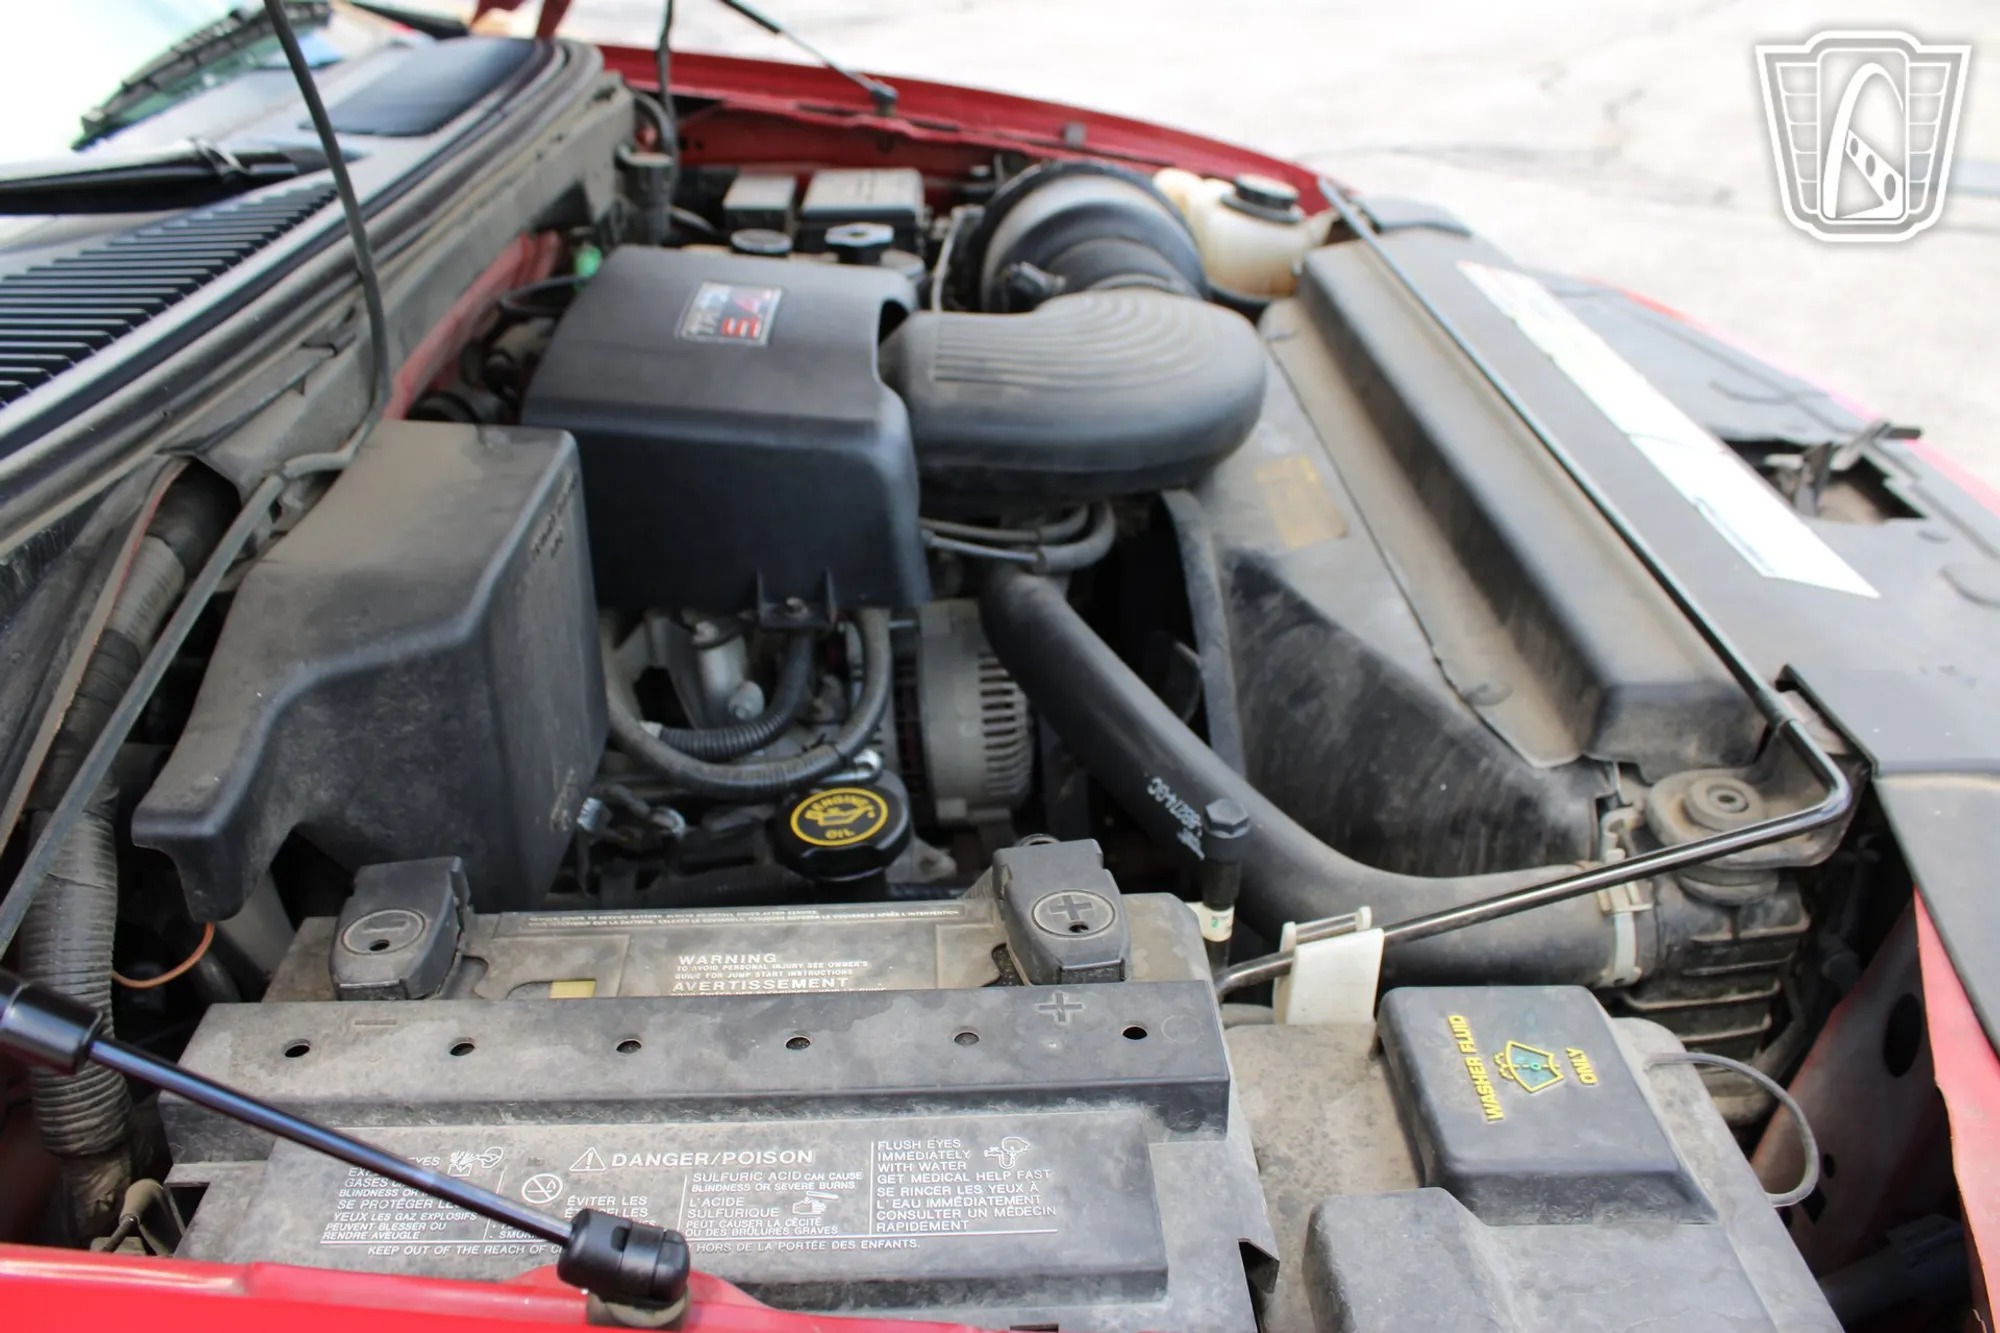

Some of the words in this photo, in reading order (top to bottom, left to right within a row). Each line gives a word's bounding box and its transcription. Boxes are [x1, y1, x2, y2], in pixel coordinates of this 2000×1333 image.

[825, 828, 855, 840] OIL
[679, 953, 777, 965] WARNING
[691, 964, 718, 972] AVOID
[722, 963, 768, 971] PERSONAL
[727, 970, 752, 979] JUMP
[787, 968, 853, 977] INSTRUCTIONS
[672, 977, 849, 992] AVERTISSEMENT
[1448, 1014, 1477, 1054] FLUID
[1566, 1047, 1599, 1085] ONLY
[1464, 1056, 1505, 1124] WASHER
[877, 1139, 921, 1150] FLUSH
[927, 1138, 961, 1149] EYES
[611, 1150, 814, 1168] DANGER/POISON
[877, 1149, 970, 1162] IMMEDIATELY
[877, 1162, 914, 1173] WITH
[919, 1160, 967, 1172] WATER
[692, 1171, 763, 1183] SULFURIC
[768, 1170, 801, 1182] ACID
[804, 1172, 825, 1182] CAN
[829, 1171, 863, 1181] CAUSE
[877, 1173, 905, 1184] GET
[911, 1172, 970, 1184] MEDICAL
[976, 1170, 1012, 1181] HELP
[1017, 1169, 1052, 1180] FAST
[344, 1178, 388, 1188] GASES
[691, 1183, 751, 1193] BLINDNESS
[755, 1182, 770, 1192] OR
[774, 1181, 815, 1191] SEVERE
[819, 1181, 856, 1190] BURNS
[877, 1186, 896, 1197] SE
[900, 1185, 951, 1197] RINCER
[957, 1184, 983, 1194] LES
[988, 1183, 1024, 1194] YEUX
[1030, 1180, 1039, 1192] À
[338, 1188, 399, 1197] BLINDNESS
[337, 1199, 355, 1210] SE
[359, 1197, 433, 1210] PROTÉGER
[567, 1194, 615, 1206] ÉVITER
[622, 1195, 648, 1206] LES
[689, 1196, 745, 1208] L'ACIDE
[926, 1194, 1041, 1208] IMMÉDIATEMENT
[333, 1212, 367, 1222] YEUX
[371, 1213, 391, 1222] LES
[395, 1212, 416, 1221] GAZ
[420, 1212, 478, 1221] EXPLOSIFS
[687, 1207, 781, 1220] SULFURIQUE
[876, 1209, 961, 1221] CONSULTER
[967, 1207, 988, 1218] UN
[994, 1204, 1056, 1217] MÉDECIN
[325, 1222, 374, 1231] PEUVENT
[378, 1222, 426, 1231] BLESSER
[430, 1222, 447, 1231] OU
[686, 1219, 715, 1229] PEUT
[719, 1218, 763, 1229] CAUSER
[767, 1218, 780, 1228] LA
[784, 1217, 822, 1228] CÉCITÉ
[876, 1220, 970, 1233] RAPIDEMENT
[322, 1231, 367, 1240] RENDRE
[371, 1231, 420, 1240] AVEUGLE
[685, 1228, 702, 1238] OU
[705, 1227, 727, 1237] DES
[794, 1226, 838, 1236] GRAVES
[368, 1245, 399, 1256] KEEP
[404, 1245, 430, 1255] OUT
[434, 1245, 451, 1255] OF
[456, 1245, 480, 1255] THE
[483, 1244, 526, 1255] REACH
[530, 1244, 548, 1254] OF
[696, 1241, 732, 1252] HORS
[736, 1241, 752, 1252] DE
[758, 1241, 773, 1251] LA
[778, 1239, 827, 1251] PORTÉE
[831, 1240, 856, 1250] DES
[861, 1239, 921, 1250] ENFANTS.
